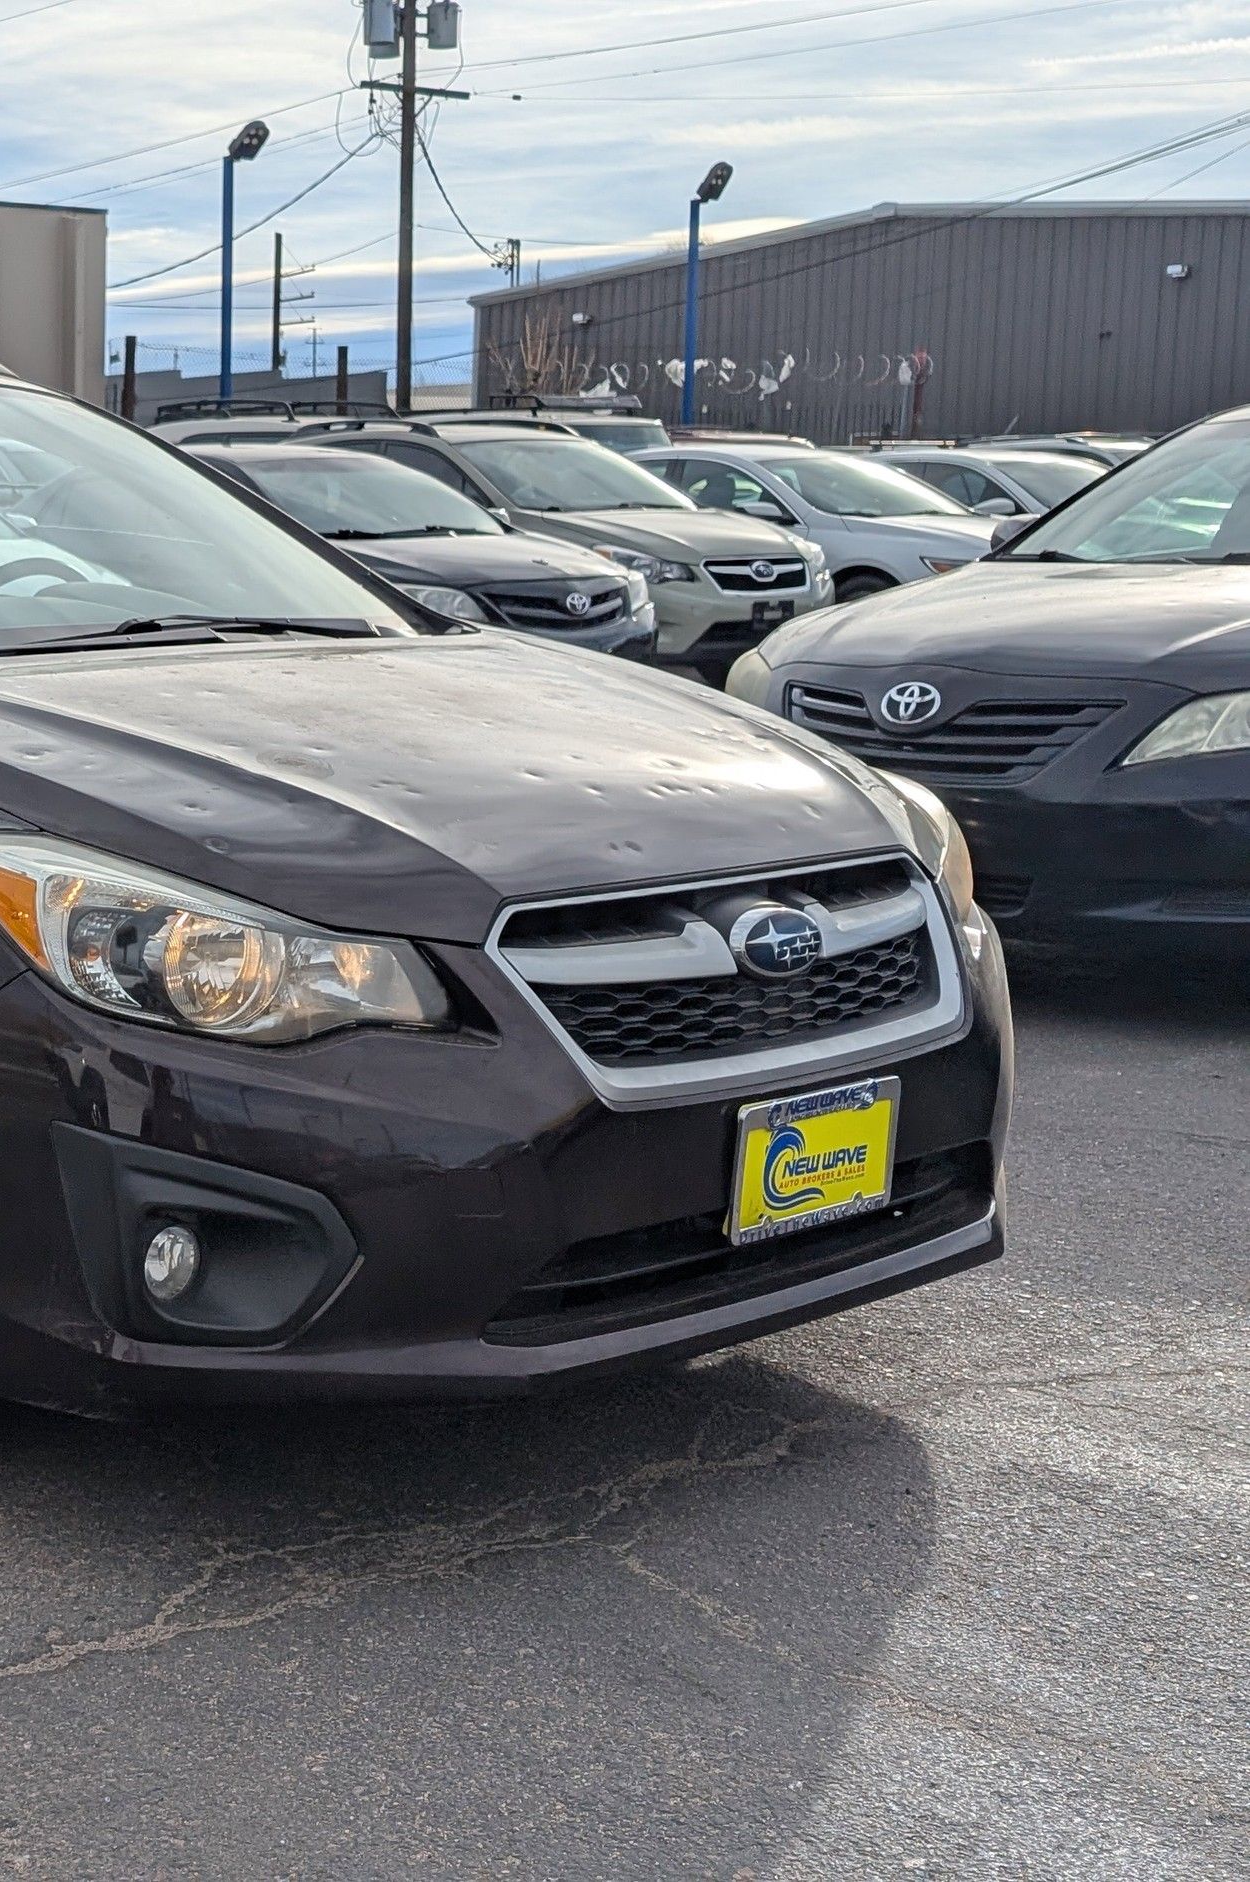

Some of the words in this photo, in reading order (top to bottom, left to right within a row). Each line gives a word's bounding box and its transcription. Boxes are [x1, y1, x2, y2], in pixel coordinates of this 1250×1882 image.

[778, 1177, 800, 1190] AUTO
[801, 1170, 835, 1185] BROKERS
[844, 1164, 865, 1176] SALES
[781, 1153, 821, 1180] NEW
[821, 1144, 868, 1170] WAVE
